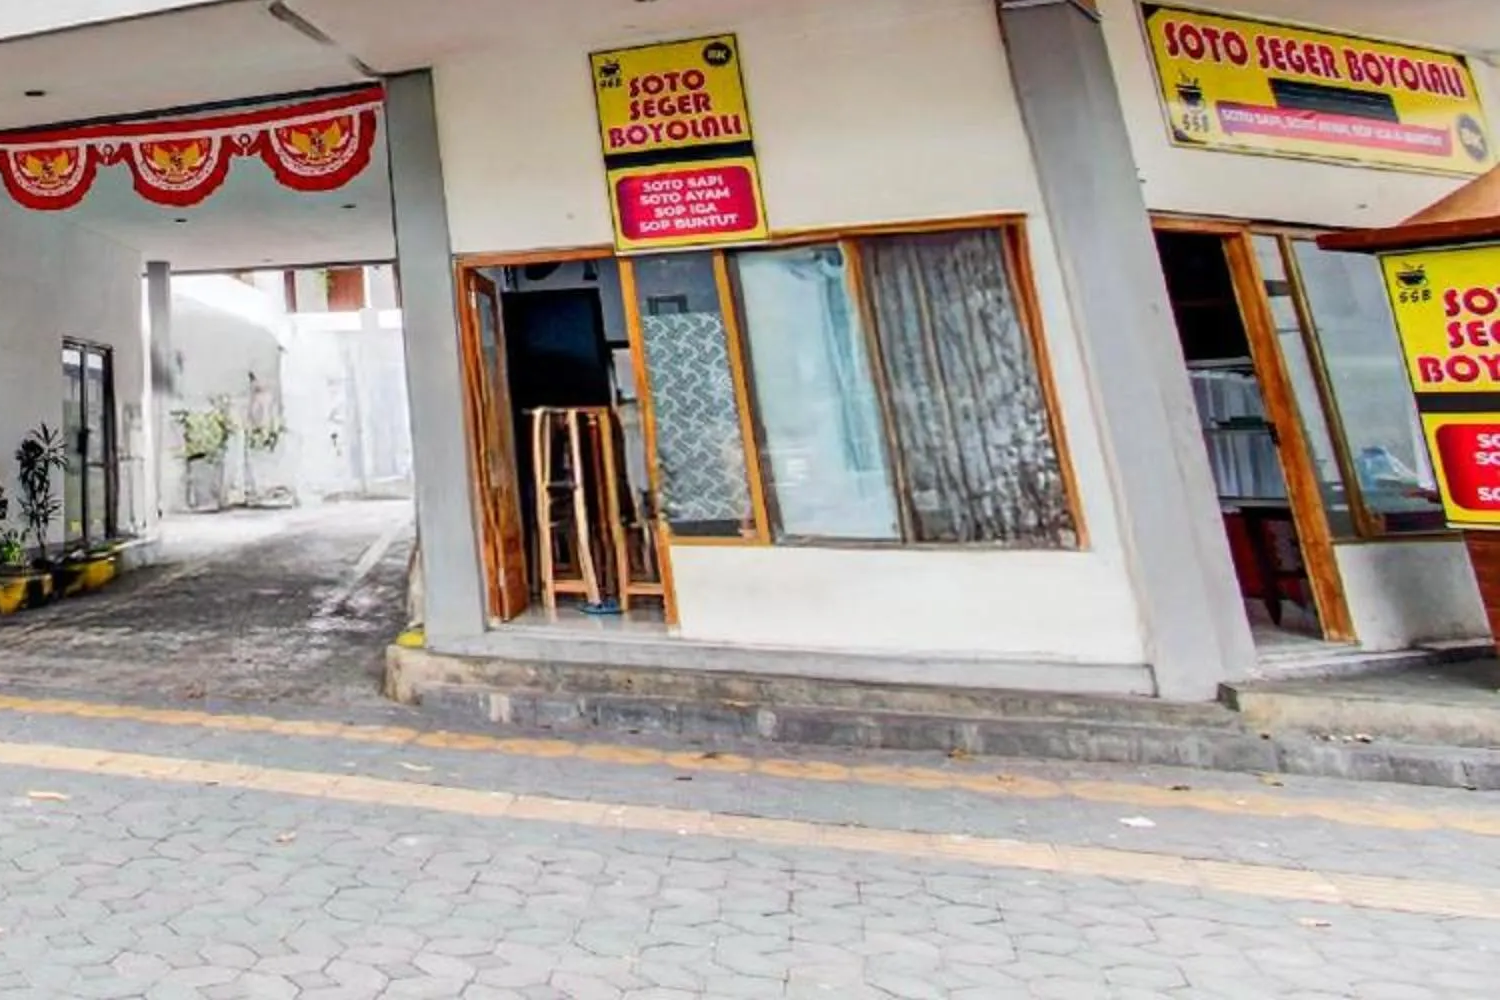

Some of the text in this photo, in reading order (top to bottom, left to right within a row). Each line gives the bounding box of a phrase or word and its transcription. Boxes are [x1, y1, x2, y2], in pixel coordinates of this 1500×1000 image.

[1164, 21, 1466, 98] SOTO SEGER BOYOLALI
[630, 69, 705, 98] SOTO
[630, 92, 711, 120] SEGER
[608, 114, 742, 148] BOYOLALI
[640, 187, 731, 205] SOTO AYAM
[643, 174, 724, 192] SOTO SAPI
[654, 202, 717, 218] SOP IGA
[639, 220, 670, 232] SOP
[1444, 287, 1500, 317] SO
